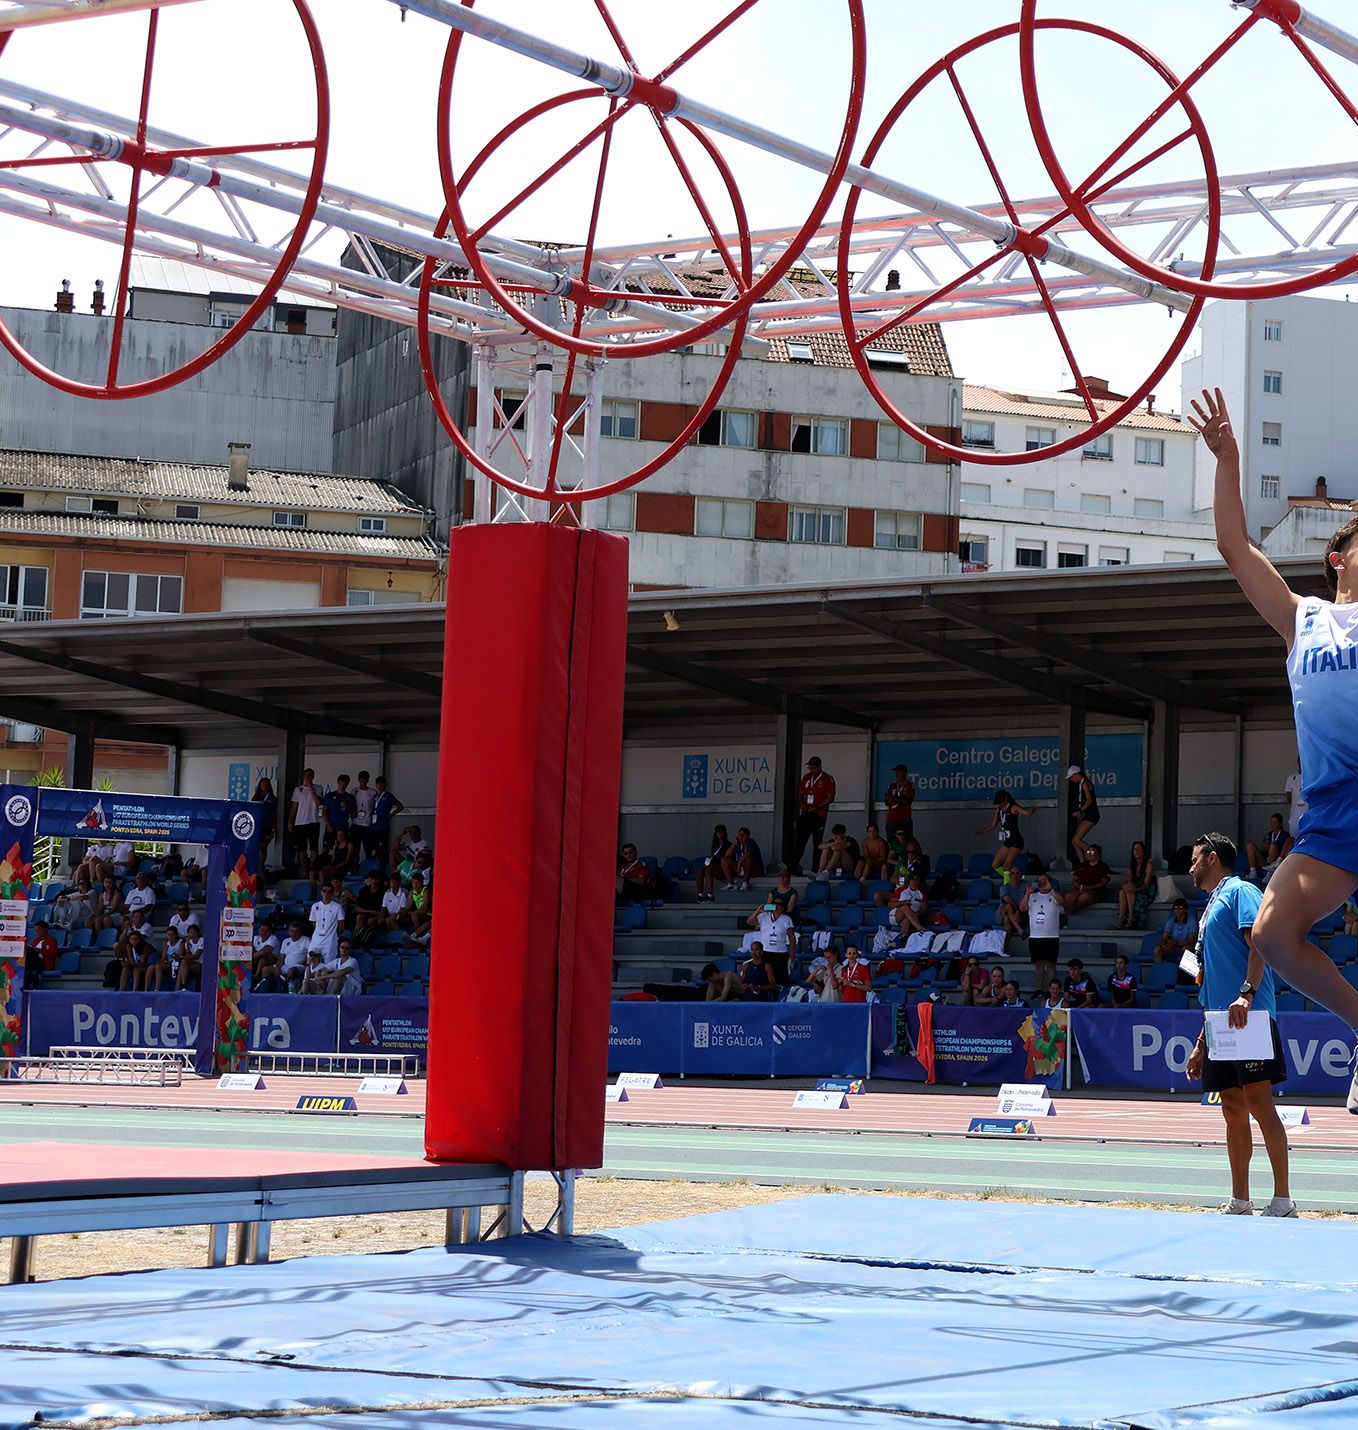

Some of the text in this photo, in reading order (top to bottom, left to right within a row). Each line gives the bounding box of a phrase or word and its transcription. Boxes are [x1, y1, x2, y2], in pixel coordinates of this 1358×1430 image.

[935, 747, 995, 765] Centro
[714, 757, 770, 774] XUNTA
[713, 778, 734, 794] DE
[910, 771, 1024, 790] Tecnificación
[72, 1003, 291, 1049] Pontevra
[711, 1024, 745, 1035] XUNTA
[711, 1036, 724, 1046] DE
[726, 1036, 764, 1047] GALICIA
[959, 1038, 1008, 1046] CHAMPIONSHIPS
[970, 1046, 992, 1054] WORLD
[992, 1046, 1013, 1054] SERIES
